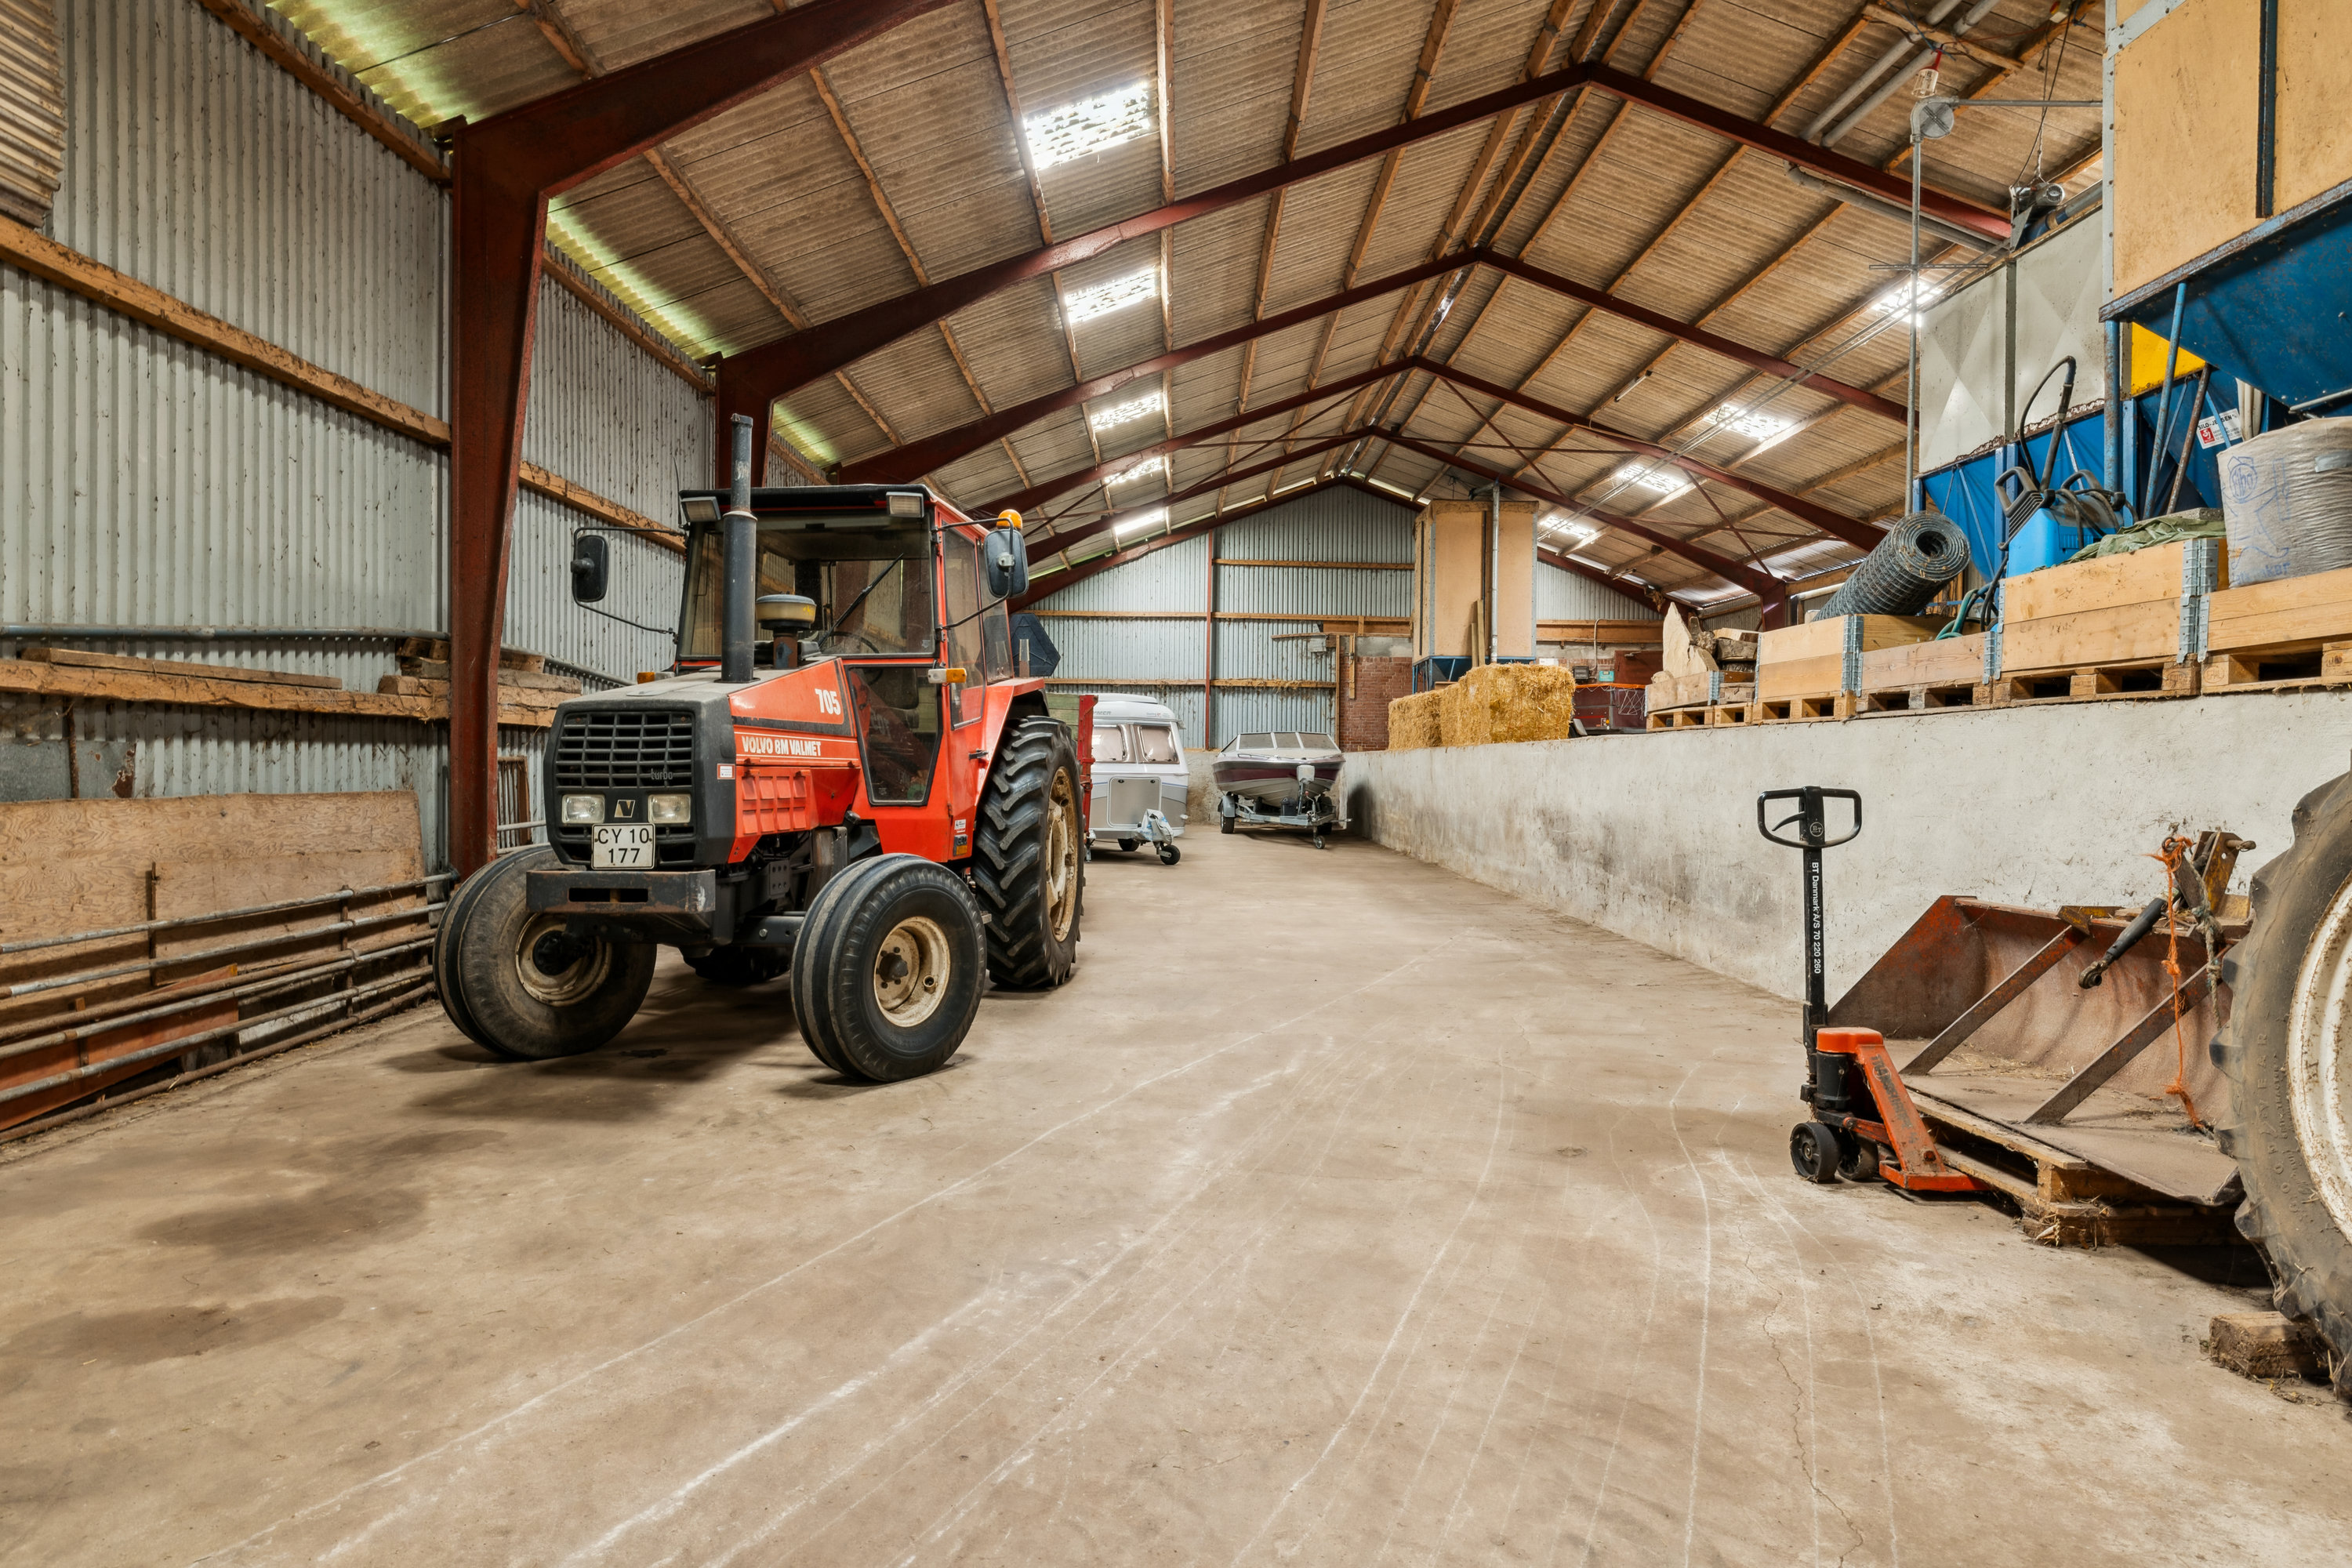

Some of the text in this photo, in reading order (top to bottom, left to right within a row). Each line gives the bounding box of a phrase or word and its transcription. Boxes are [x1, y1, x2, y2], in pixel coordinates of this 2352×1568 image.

[2198, 415, 2233, 430] SILO-JESEN
[815, 688, 841, 715] 705
[742, 735, 821, 757] VOLVO BM VALMET
[651, 768, 673, 780] turbo
[597, 828, 649, 844] CY 10
[608, 848, 641, 863] 177
[1812, 862, 1820, 873] BT
[1813, 930, 1820, 940] 70
